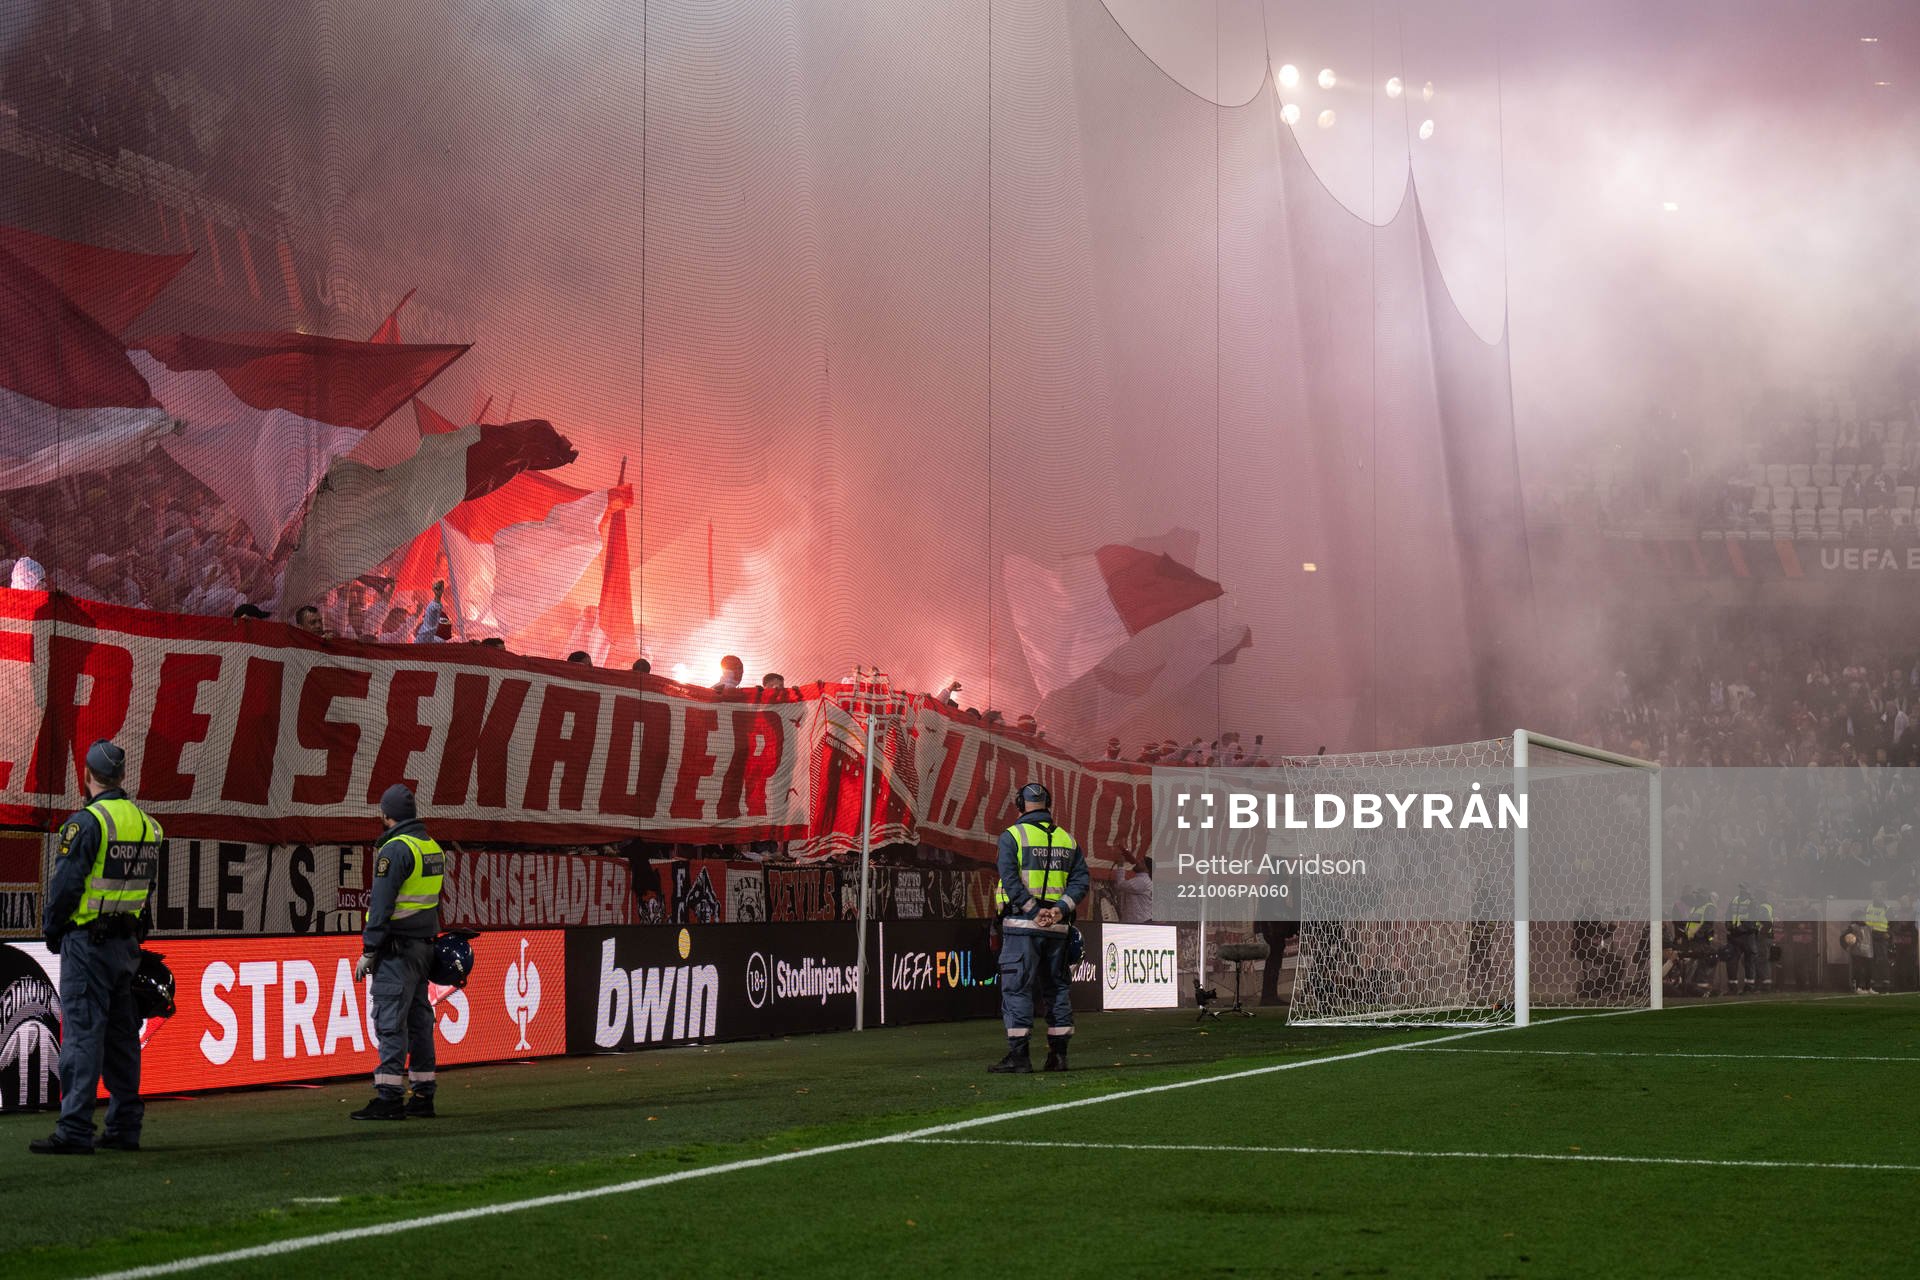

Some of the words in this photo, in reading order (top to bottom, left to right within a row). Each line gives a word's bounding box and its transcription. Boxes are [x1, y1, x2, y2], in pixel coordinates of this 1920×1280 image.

[1820, 547, 1898, 570] UEFA
[443, 850, 626, 926] SACHSENADLER
[769, 869, 835, 921] DEVILS
[594, 928, 719, 1048] bwin
[750, 970, 765, 991] 18+
[891, 952, 933, 991] UEFA
[1123, 948, 1175, 984] RESPECT
[200, 957, 470, 1066] STRAS
